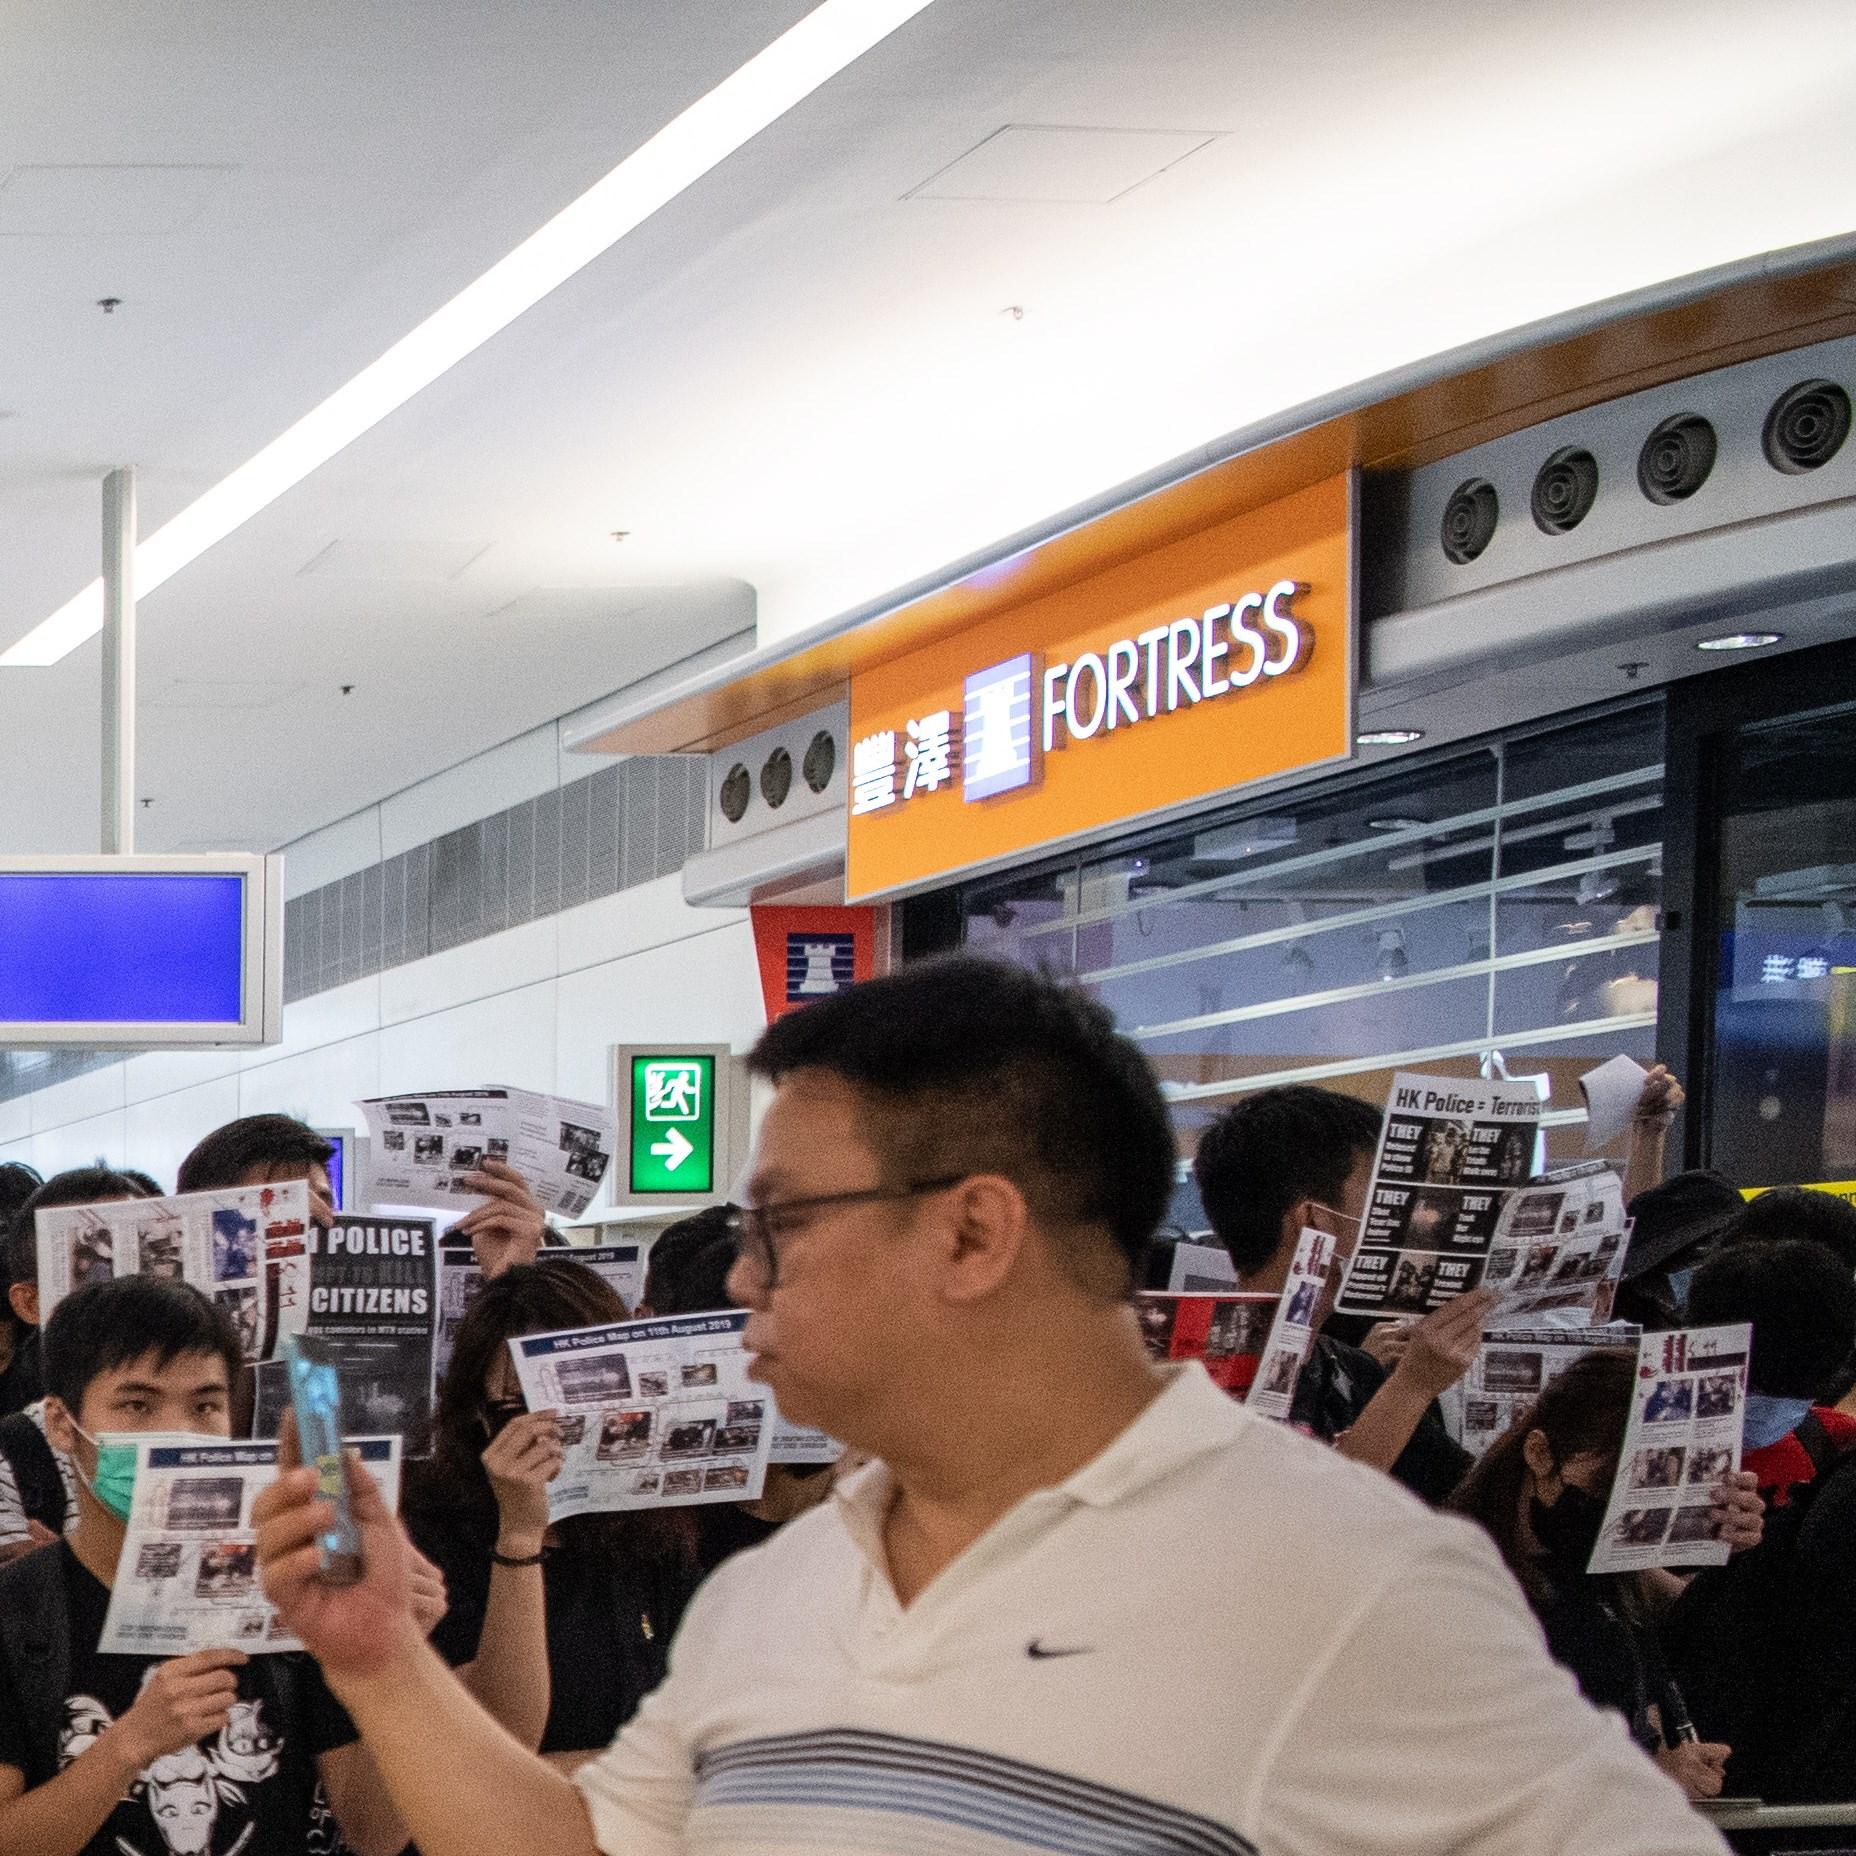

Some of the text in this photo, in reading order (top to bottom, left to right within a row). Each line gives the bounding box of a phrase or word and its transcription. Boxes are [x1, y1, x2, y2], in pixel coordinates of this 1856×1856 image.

[1042, 580, 1302, 752] FORTRESS
[852, 709, 954, 816] 豐澤
[1396, 1087, 1474, 1114] HK Police
[1390, 1123, 1423, 1140] THEY
[1472, 1127, 1502, 1143] THEY
[1376, 1189, 1410, 1206] THEY
[1463, 1196, 1492, 1211] THEY
[327, 1226, 425, 1256] POLICE
[1355, 1256, 1389, 1270] THEY
[1438, 1262, 1471, 1278] THEY
[311, 1287, 428, 1314] CITIZENS
[572, 1335, 604, 1349] Police
[607, 1330, 630, 1345] Map
[633, 1331, 645, 1339] on
[670, 1321, 706, 1338] August
[708, 1320, 731, 1332] 2019
